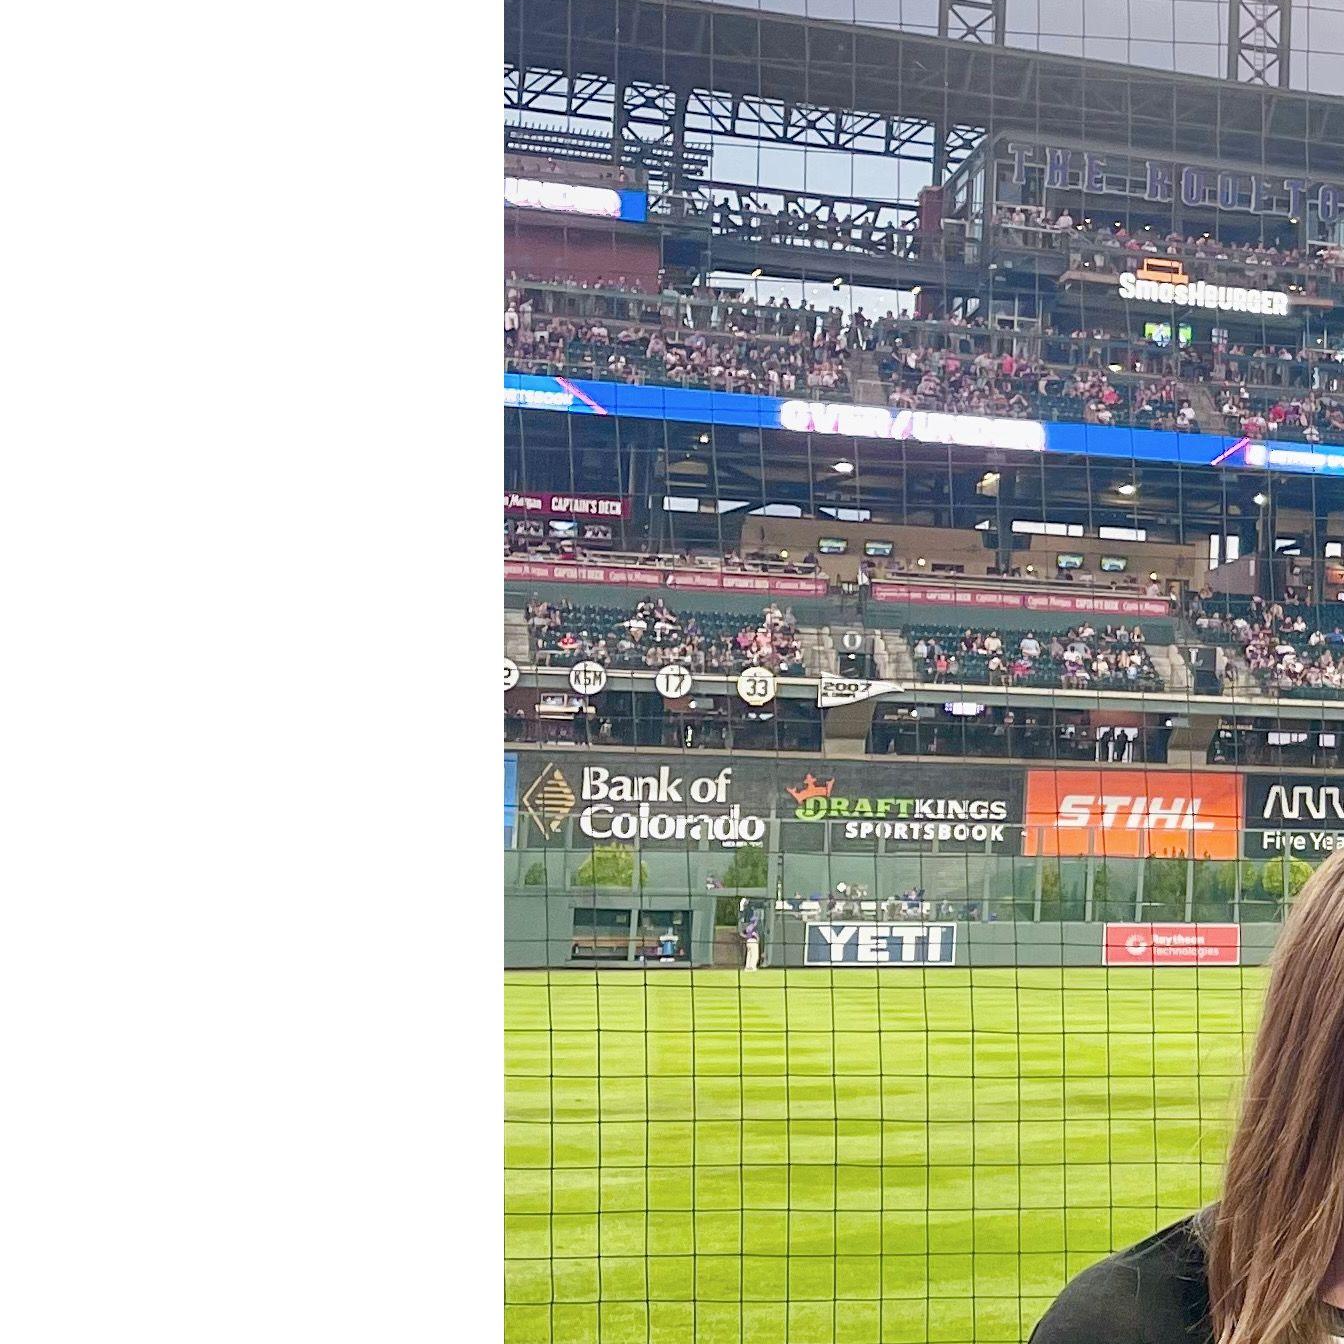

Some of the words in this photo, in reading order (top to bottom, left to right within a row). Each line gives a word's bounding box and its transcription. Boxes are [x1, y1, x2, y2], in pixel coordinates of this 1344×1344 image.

[1008, 143, 1106, 192] THE
[747, 679, 768, 696] 33
[823, 682, 872, 692] 2007
[581, 766, 683, 802] Bank
[690, 767, 732, 803] of
[580, 803, 766, 841] Colorado
[795, 796, 1008, 821] DRAFTKINGS
[1054, 795, 1216, 830] STIHL
[845, 822, 1005, 842] SPORTSBOOK
[1262, 832, 1306, 851] Five
[818, 926, 943, 962] YETI
